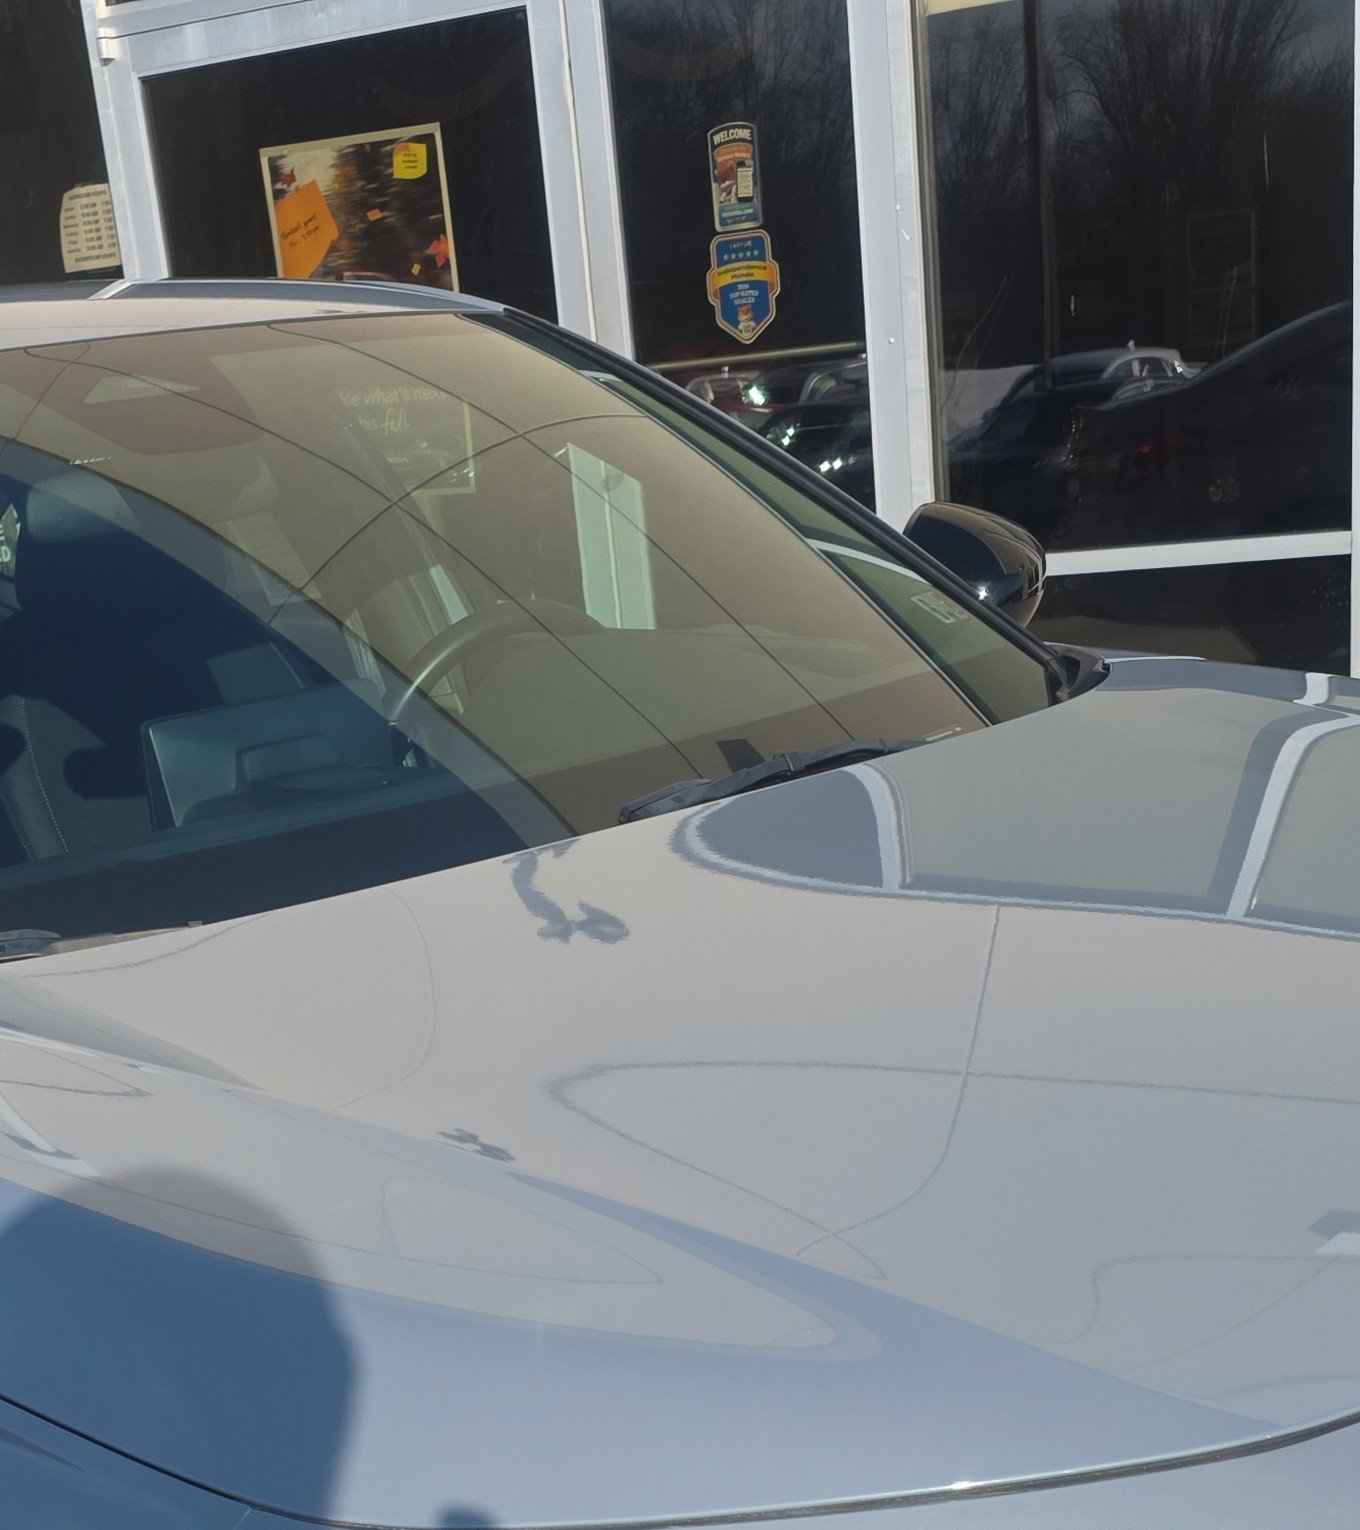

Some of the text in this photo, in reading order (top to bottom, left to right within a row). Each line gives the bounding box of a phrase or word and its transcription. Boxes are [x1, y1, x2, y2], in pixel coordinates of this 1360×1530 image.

[712, 127, 753, 146] WELCOME
[717, 263, 768, 276] Independence
[731, 271, 755, 280] Honda
